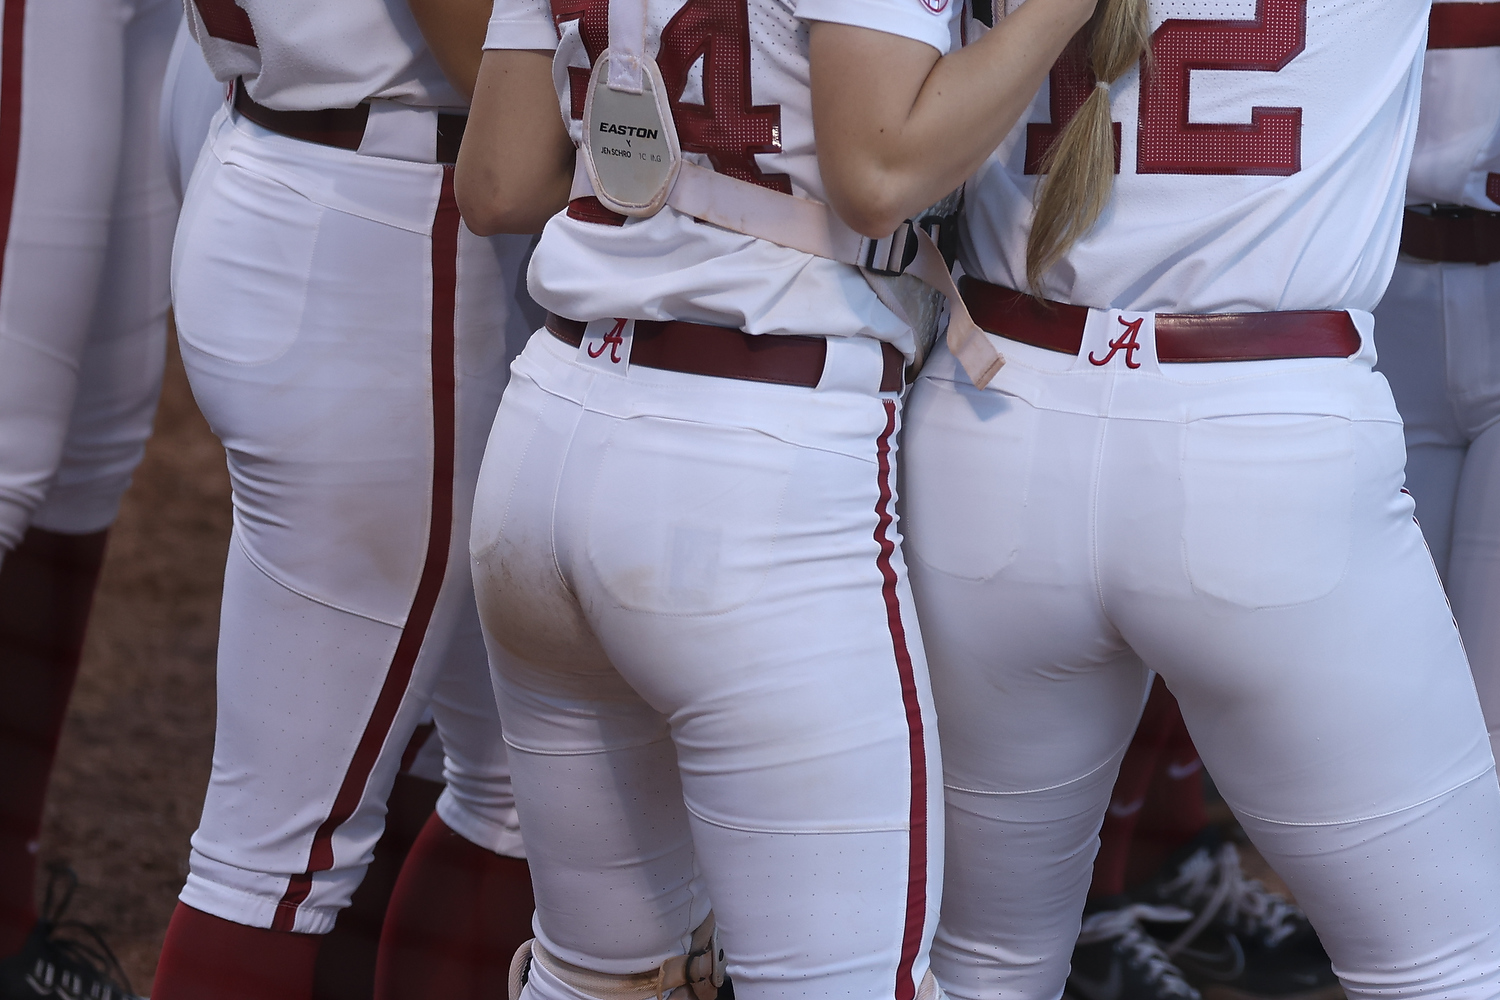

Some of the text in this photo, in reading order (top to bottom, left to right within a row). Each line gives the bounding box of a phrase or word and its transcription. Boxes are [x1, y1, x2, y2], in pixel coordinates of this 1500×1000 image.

[599, 122, 658, 140] EASTON
[587, 317, 629, 364] A
[1087, 316, 1147, 370] A
